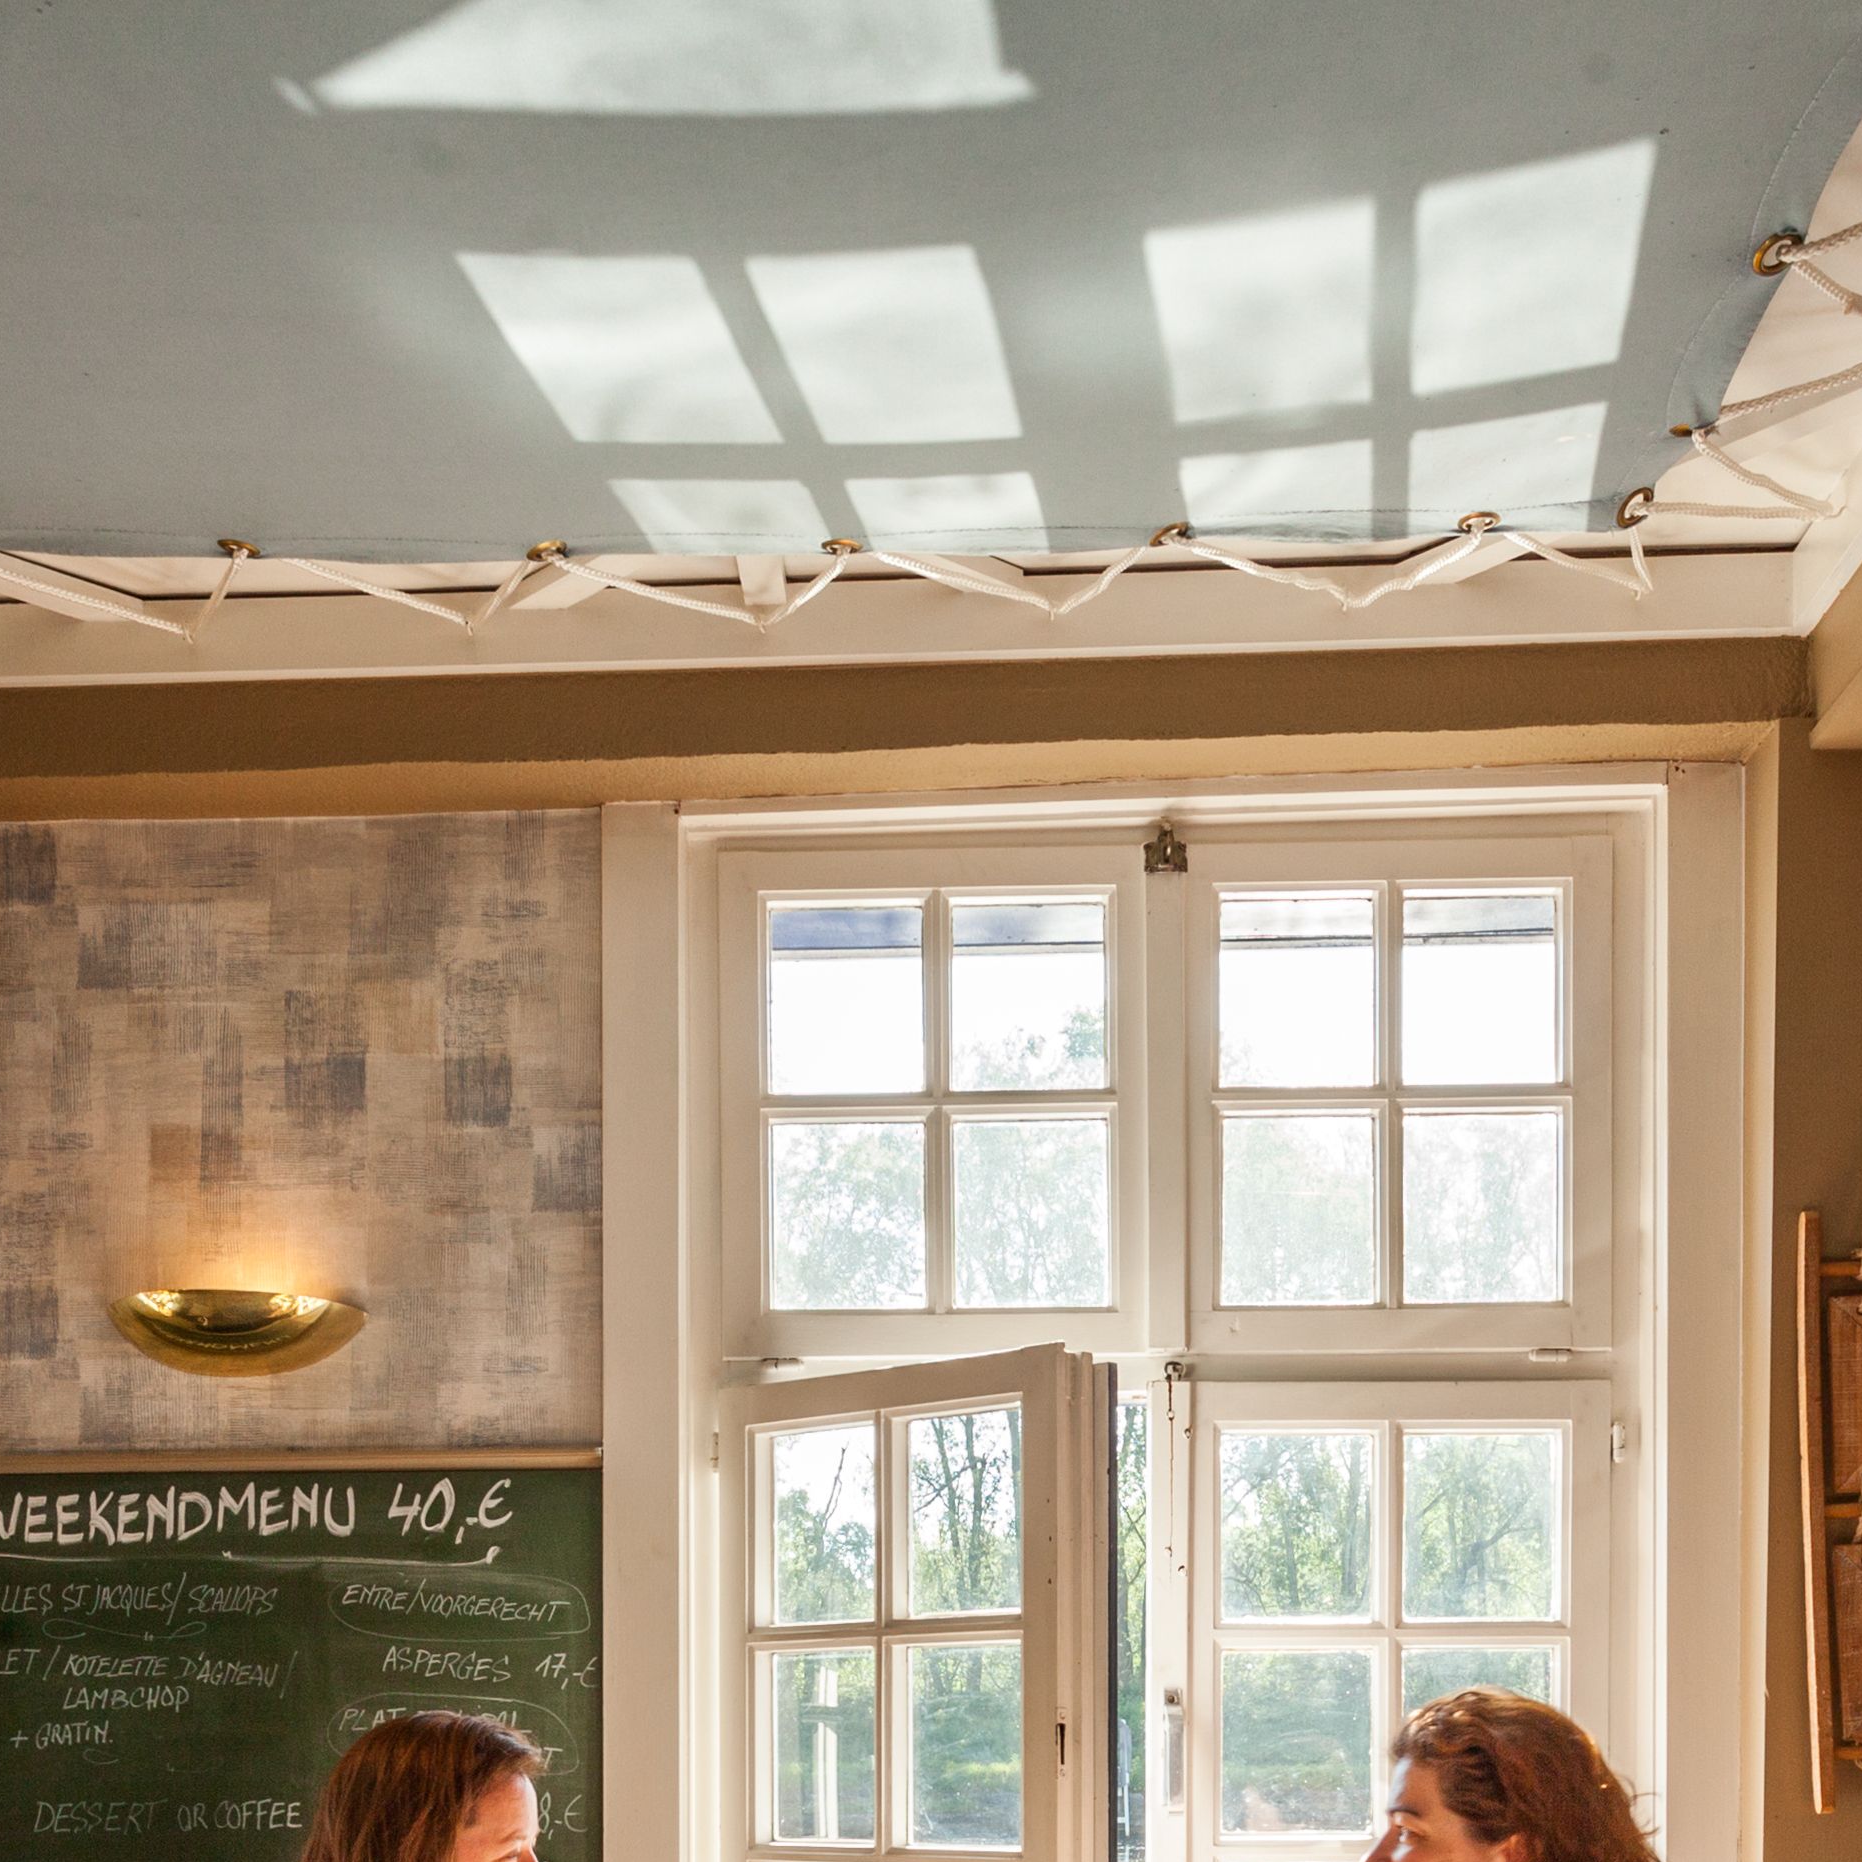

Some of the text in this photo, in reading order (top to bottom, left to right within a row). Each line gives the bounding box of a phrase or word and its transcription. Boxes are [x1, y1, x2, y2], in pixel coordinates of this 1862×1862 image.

[62, 1653, 170, 1678] KOTELETTE
[382, 1645, 511, 1682] ASPERGES
[63, 1685, 190, 1713] LAMBCHOP
[339, 1707, 407, 1732] PLAT
[33, 1798, 303, 1834] DESSERT OR COFFEE
